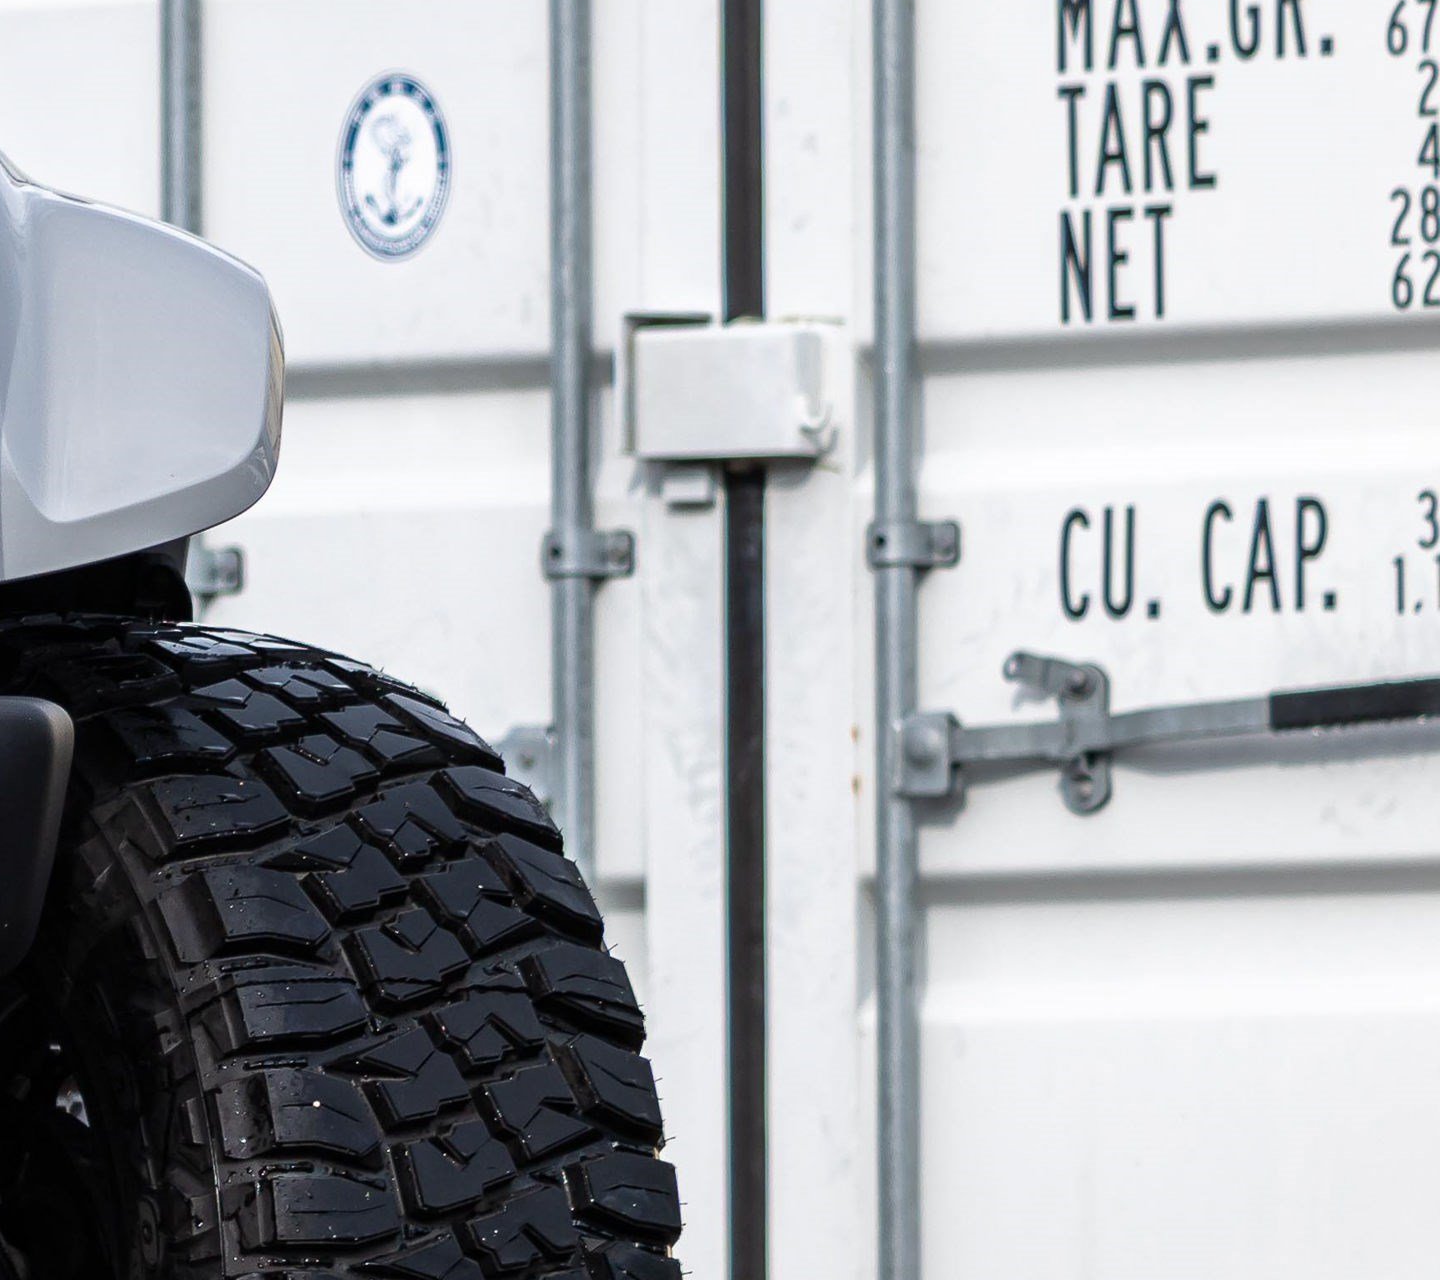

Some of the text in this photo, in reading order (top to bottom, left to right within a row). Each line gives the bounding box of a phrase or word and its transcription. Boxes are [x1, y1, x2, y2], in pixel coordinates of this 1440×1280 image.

[1058, 75, 1217, 198] TARE
[1060, 204, 1173, 324] NET
[1059, 506, 1161, 621] CU.
[1202, 497, 1337, 614] CAP.
